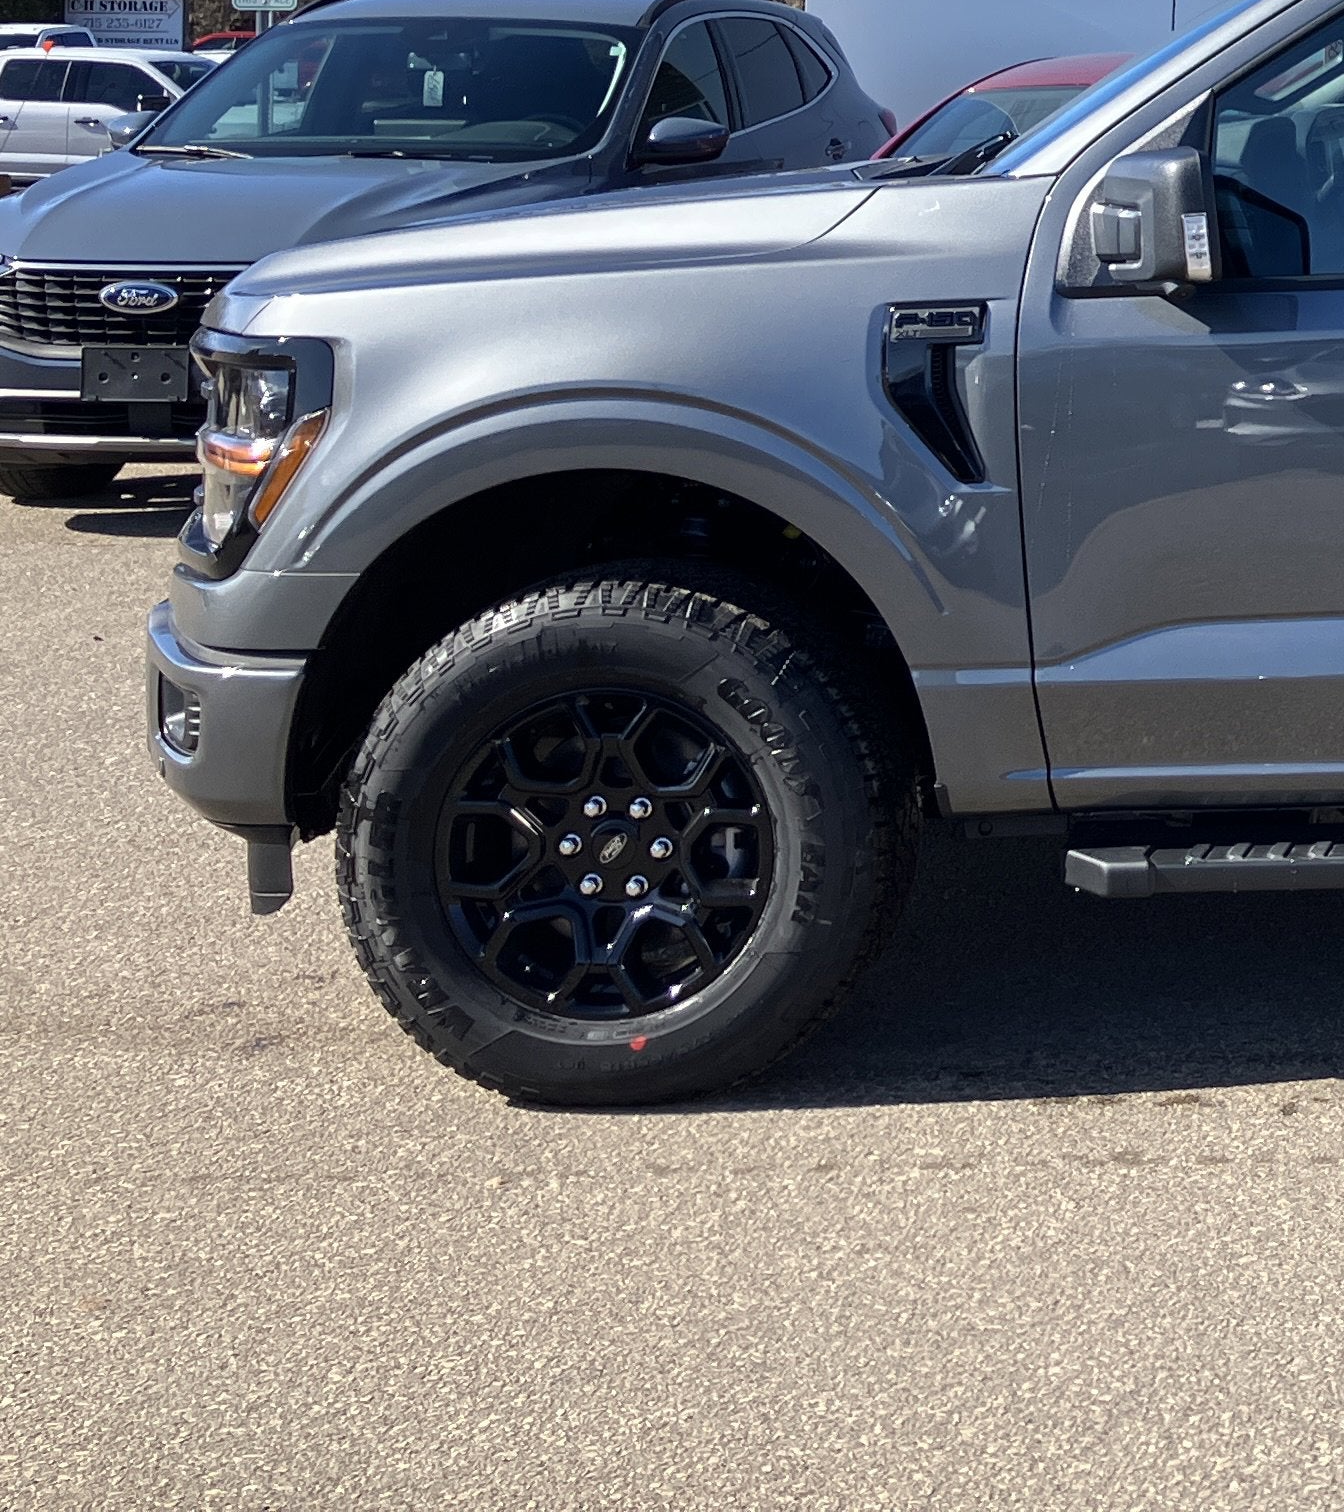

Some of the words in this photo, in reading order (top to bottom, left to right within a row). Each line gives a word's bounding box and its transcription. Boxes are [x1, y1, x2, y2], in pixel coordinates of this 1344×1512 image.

[99, 0, 169, 12] STORAGE
[83, 17, 102, 29] 715
[117, 288, 159, 306] Ford
[895, 311, 979, 328] F-150
